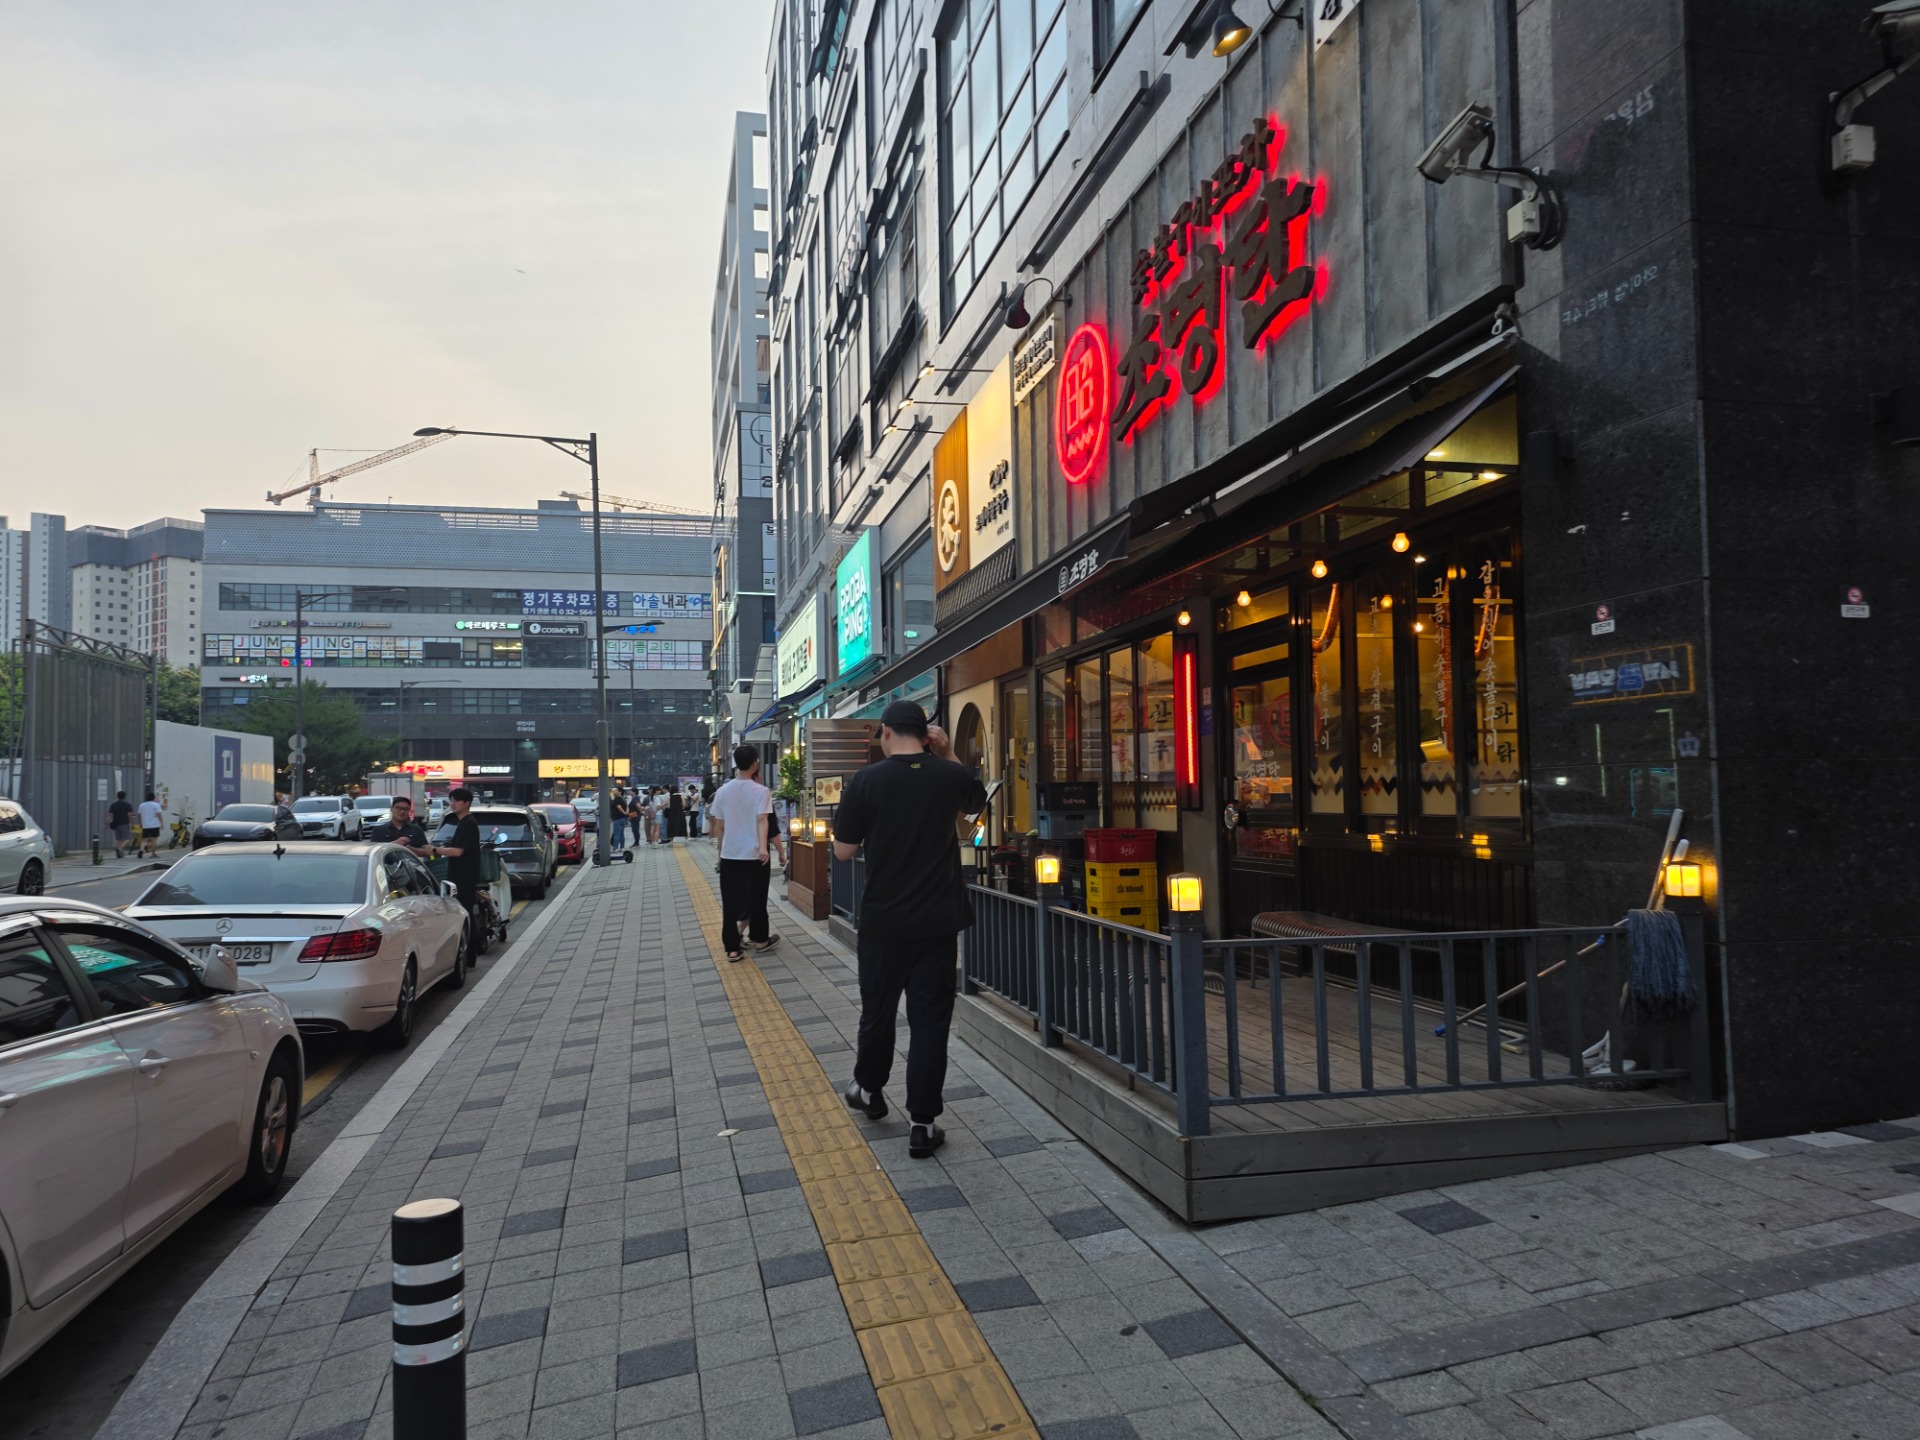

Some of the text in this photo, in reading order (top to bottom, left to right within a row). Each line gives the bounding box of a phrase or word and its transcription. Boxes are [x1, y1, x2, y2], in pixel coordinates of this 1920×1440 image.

[1112, 178, 1314, 441] 조명탄
[1070, 549, 1098, 585] 조명탄
[523, 591, 618, 608] 정기주차모중
[633, 594, 688, 609] 아솔내과
[841, 565, 866, 619] PPOBA
[845, 603, 864, 647] PING
[1245, 760, 1281, 778] 조명탄
